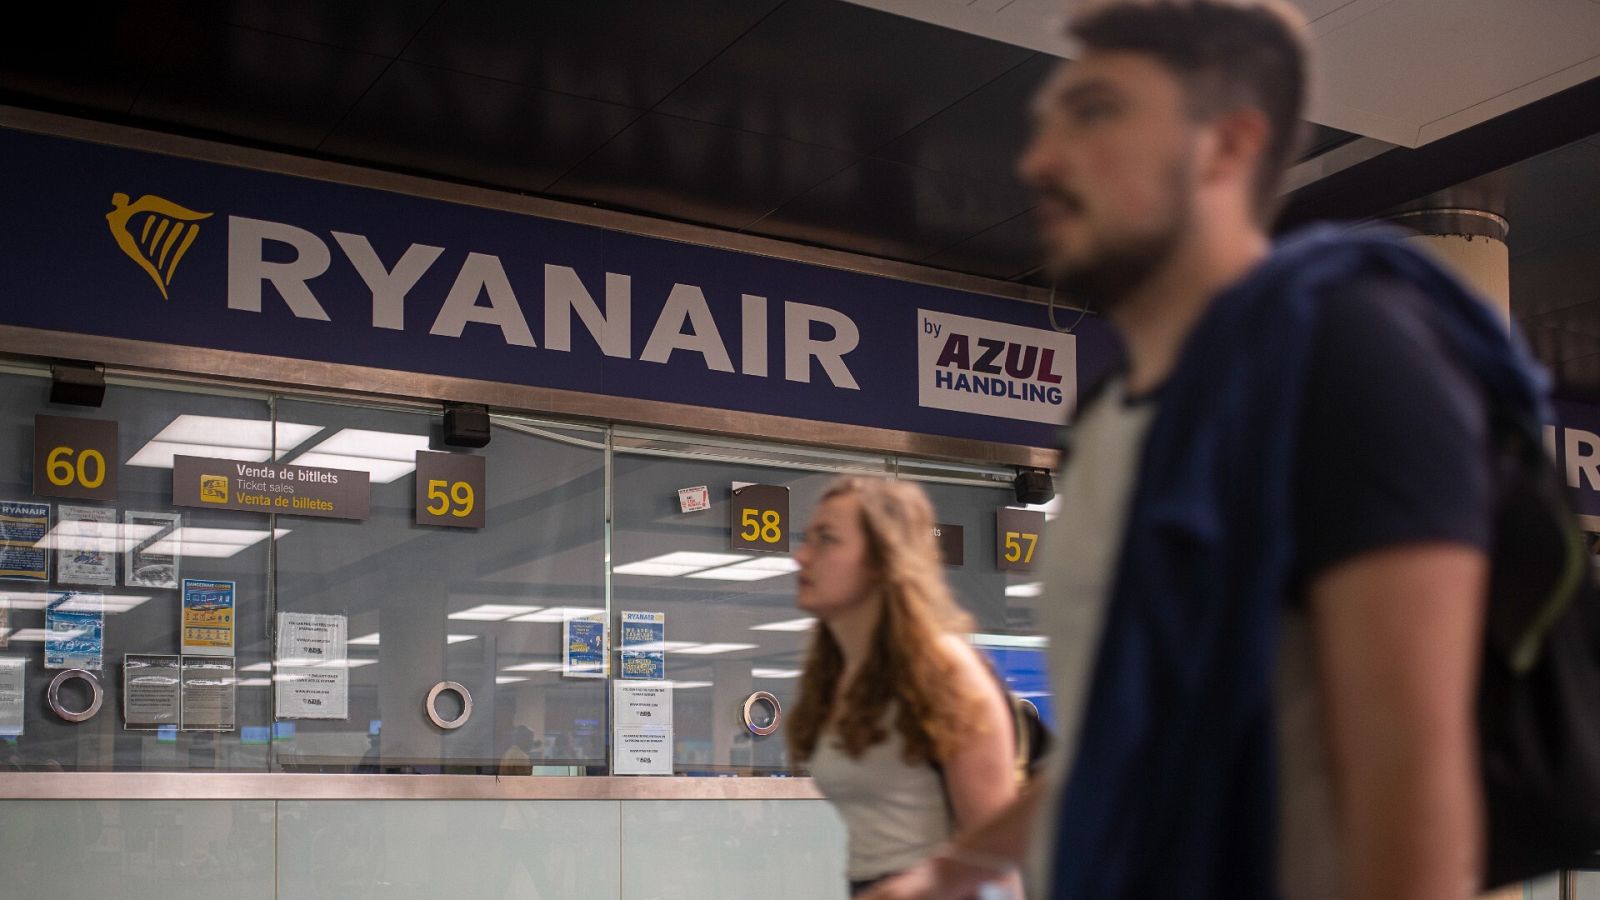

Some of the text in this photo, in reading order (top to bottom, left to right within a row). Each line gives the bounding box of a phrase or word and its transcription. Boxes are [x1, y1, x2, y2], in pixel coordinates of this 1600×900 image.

[227, 214, 862, 391] RYANAIR
[924, 317, 942, 338] by
[936, 332, 1063, 384] AZUL
[935, 369, 1063, 405] HANDLING
[45, 445, 106, 489] 60
[236, 463, 338, 484] Venda de bitllets
[236, 478, 295, 494] Ticket sales
[236, 491, 334, 511] Venta de billetes
[426, 479, 475, 518] 59
[2, 506, 46, 516] RYANAIR
[740, 508, 782, 543] 58
[1004, 531, 1039, 564] 57
[627, 613, 655, 621] RYANAIR
